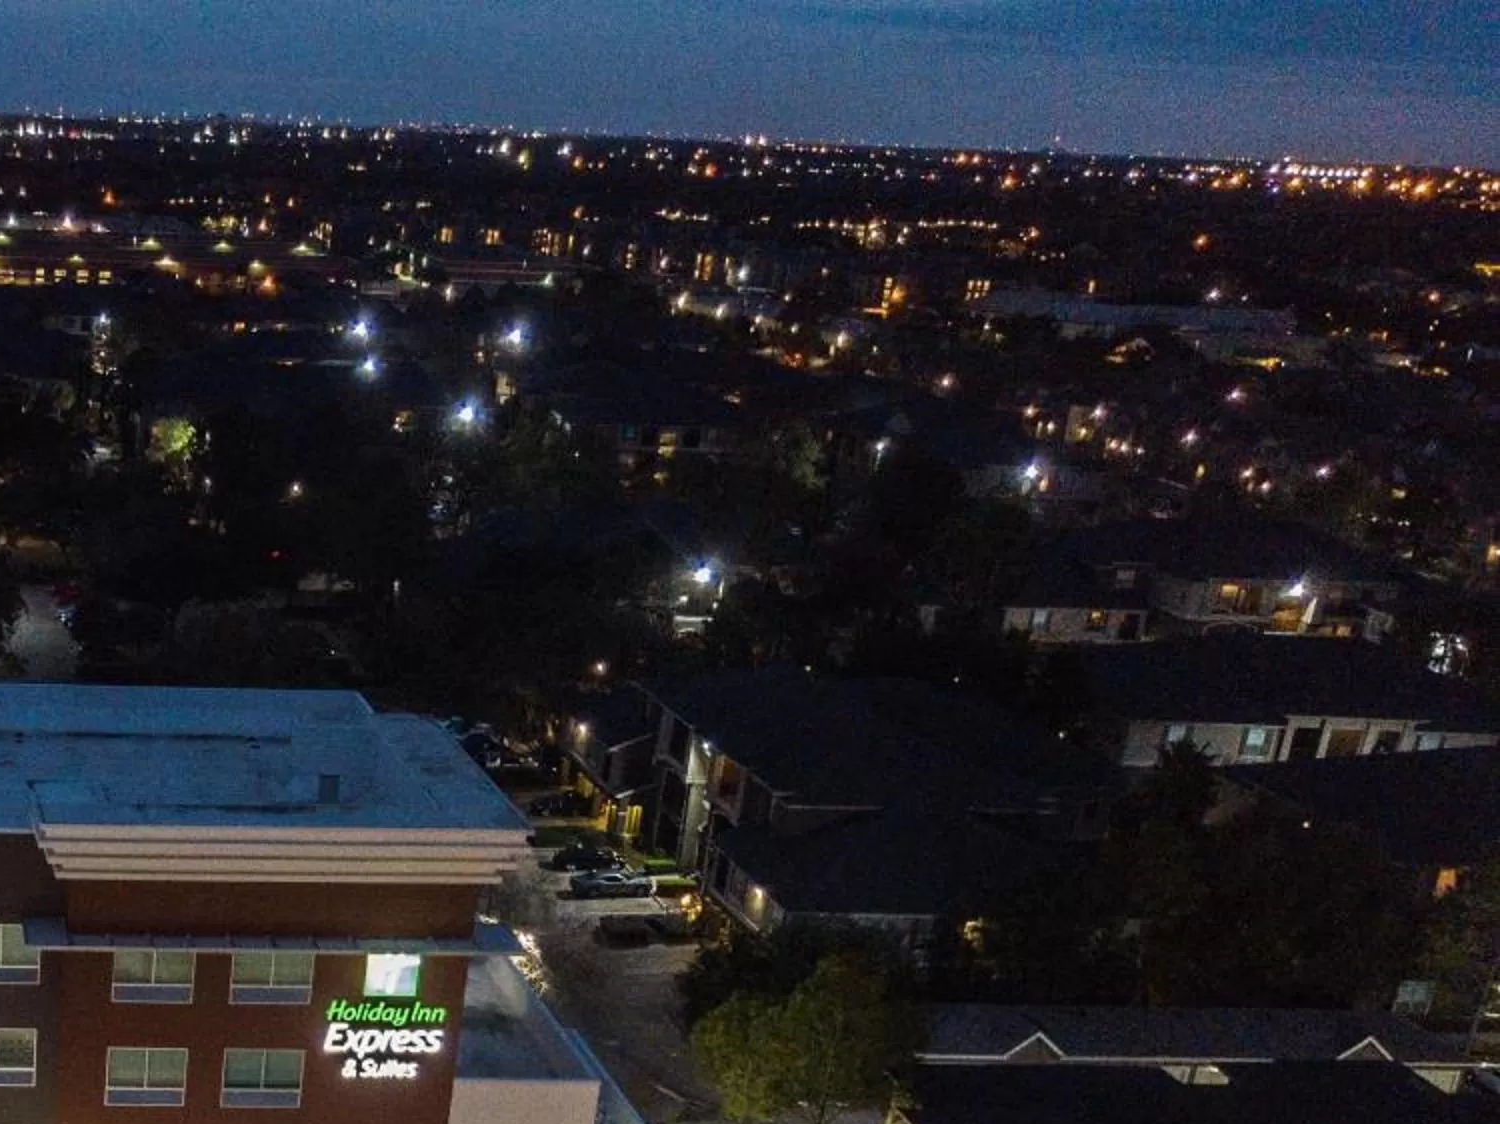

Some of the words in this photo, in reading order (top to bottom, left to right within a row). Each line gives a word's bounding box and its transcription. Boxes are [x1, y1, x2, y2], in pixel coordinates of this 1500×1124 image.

[326, 1000, 409, 1026] Holiday
[411, 1001, 446, 1022] Inn
[323, 1022, 444, 1059] Express
[341, 1058, 357, 1078] &
